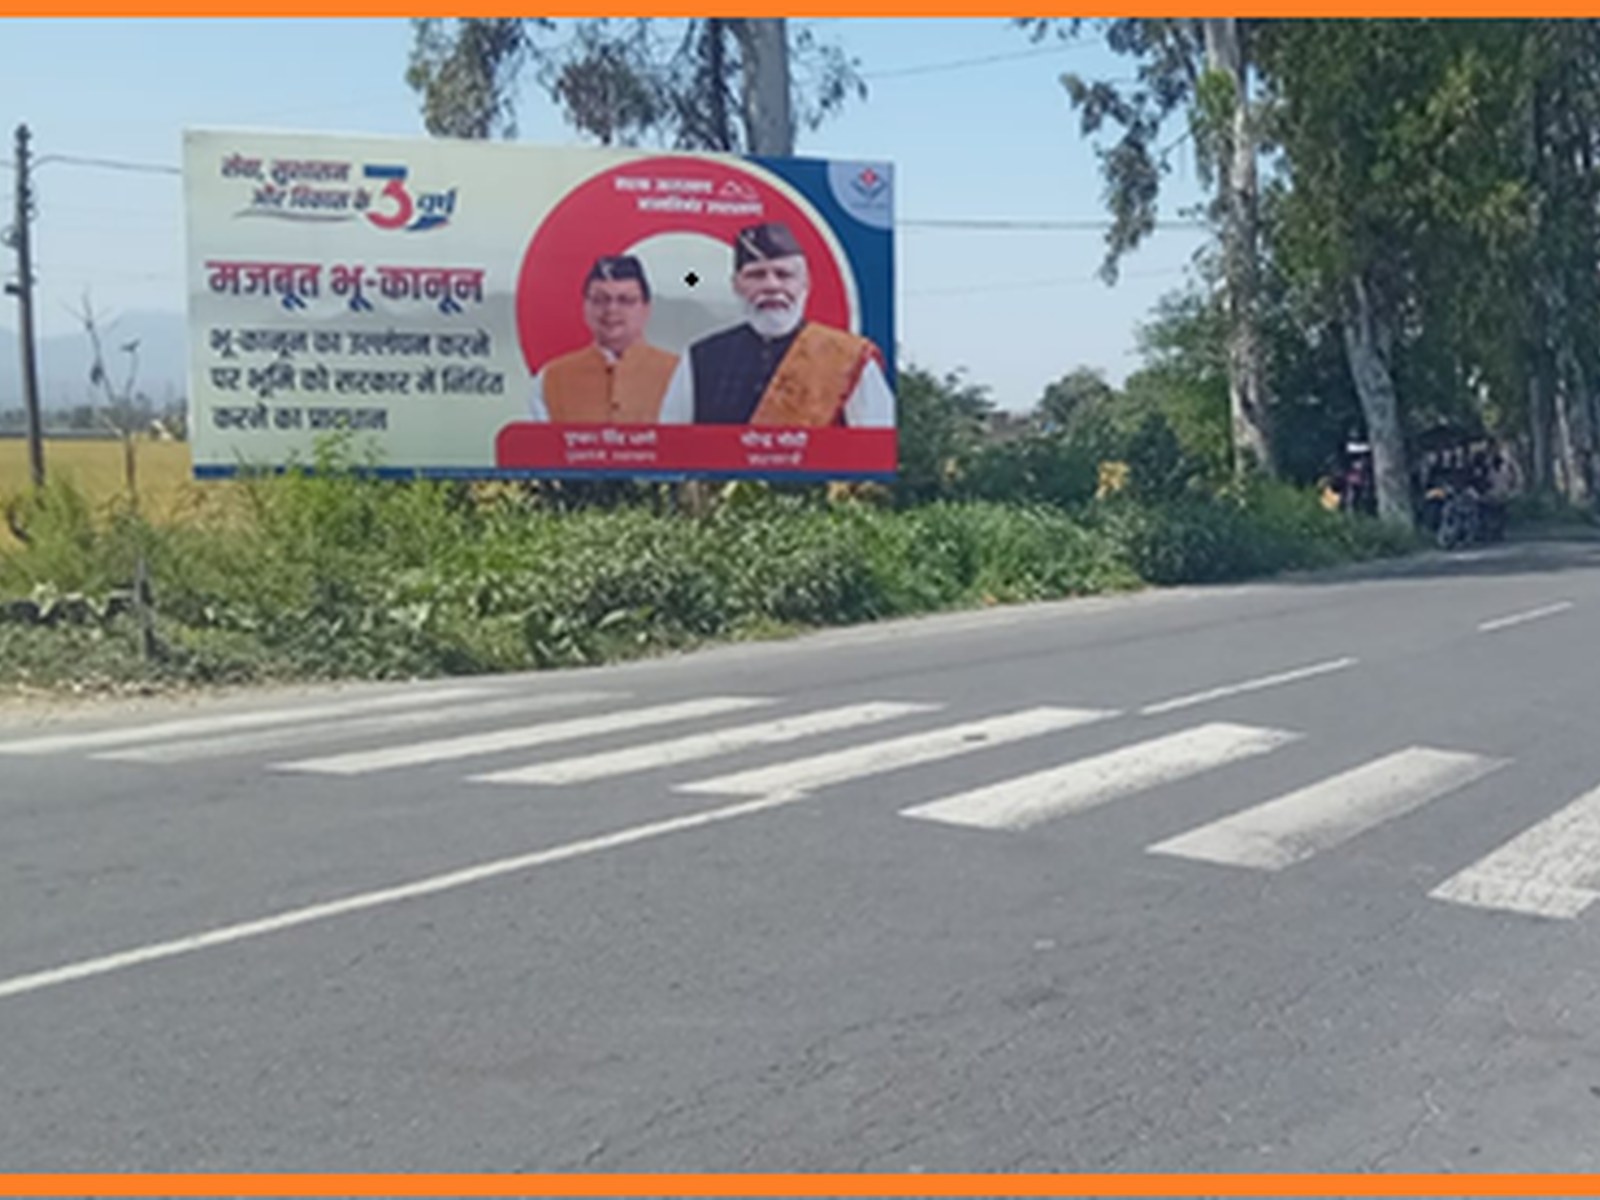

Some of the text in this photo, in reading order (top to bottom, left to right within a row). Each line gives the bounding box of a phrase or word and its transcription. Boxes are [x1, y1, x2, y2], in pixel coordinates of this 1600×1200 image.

[363, 164, 413, 229] 3
[205, 260, 485, 314] मजबूत भू-कानून
[312, 330, 342, 354] का
[435, 328, 492, 358] करने
[210, 366, 241, 391] पर
[247, 362, 295, 398] भूमि
[300, 363, 330, 392] को
[333, 368, 411, 395] सरकार
[211, 401, 269, 429] करने
[273, 406, 302, 430] का
